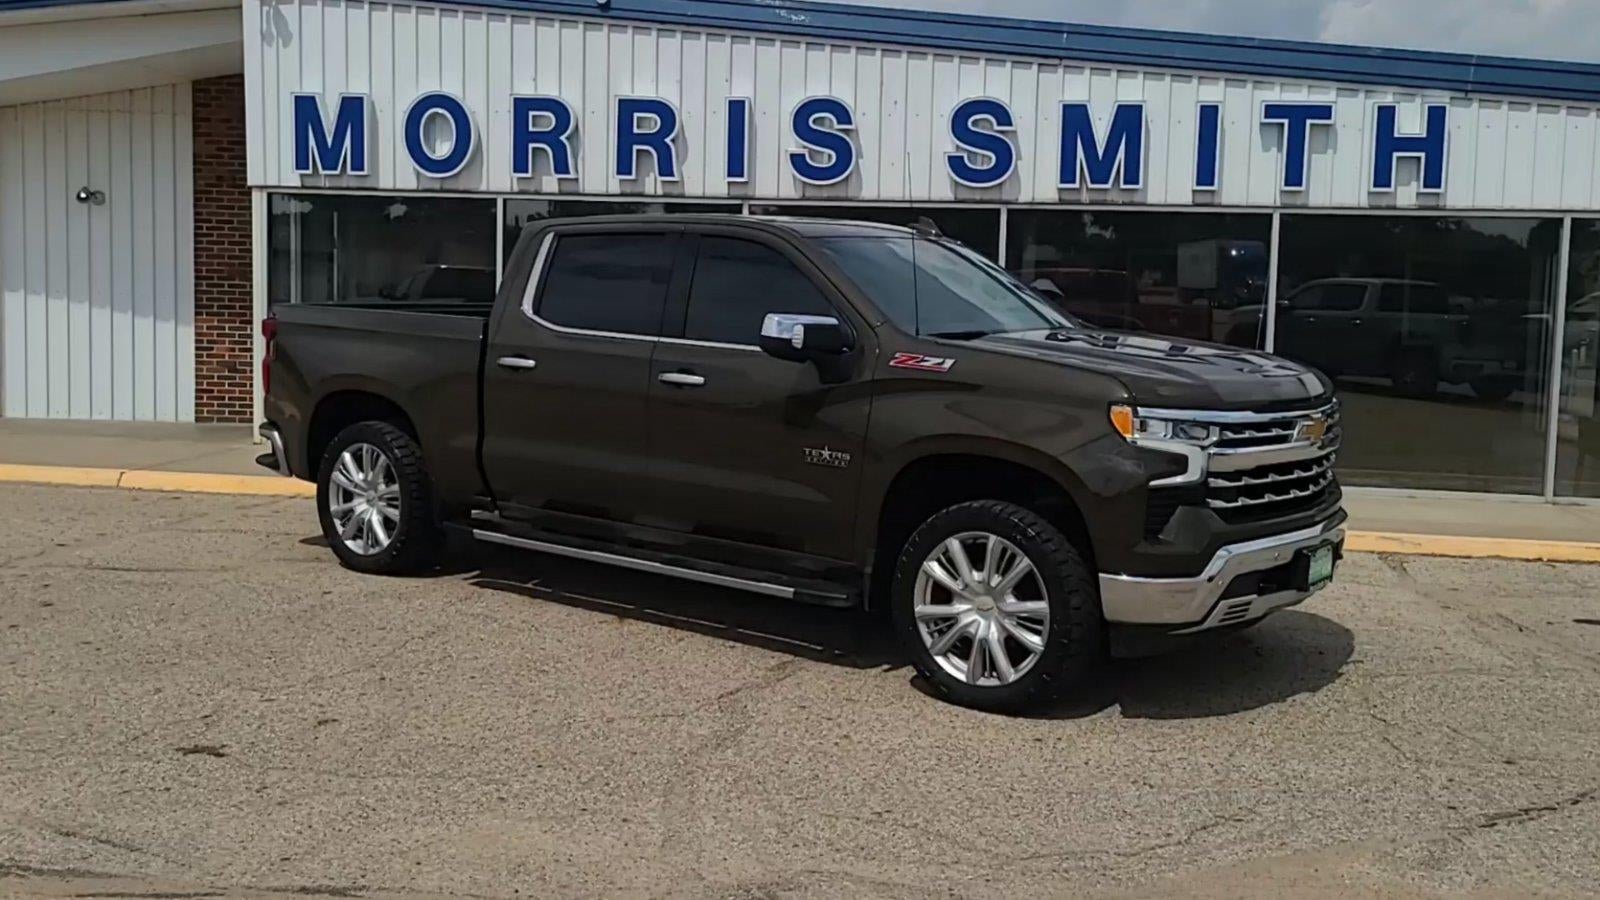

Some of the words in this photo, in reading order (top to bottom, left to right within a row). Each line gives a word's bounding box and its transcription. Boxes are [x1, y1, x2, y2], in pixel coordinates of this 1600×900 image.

[292, 92, 855, 184] MORRIS
[946, 97, 1448, 193] SMITH
[889, 352, 956, 372] Z71
